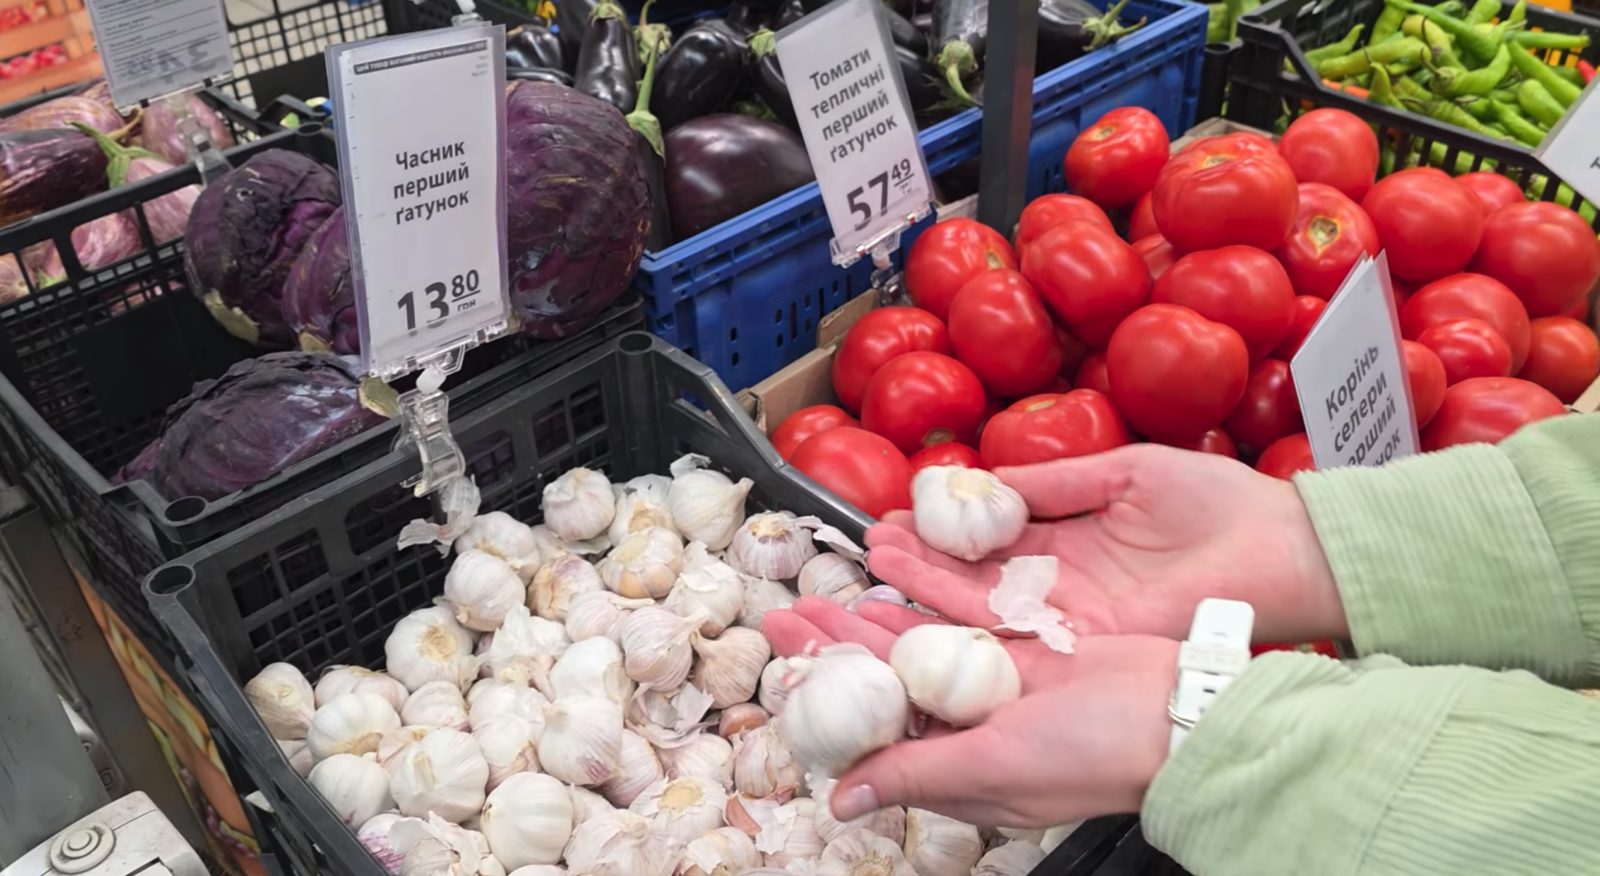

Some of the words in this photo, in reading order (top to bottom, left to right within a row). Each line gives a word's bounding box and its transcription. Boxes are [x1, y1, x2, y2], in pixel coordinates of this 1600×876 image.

[810, 48, 871, 90] Томати
[810, 64, 885, 119] тепличні
[822, 91, 889, 141] перший
[830, 114, 897, 162] ґатунок
[394, 163, 469, 198] перший
[396, 141, 465, 170] Часник
[396, 191, 469, 224] ґатунок
[847, 171, 888, 232] 57
[891, 158, 911, 180] 49
[398, 282, 449, 336] 13
[452, 269, 479, 297] 80
[1326, 346, 1379, 421] Корінь
[1334, 372, 1387, 453] селери
[1348, 394, 1396, 467] ерший
